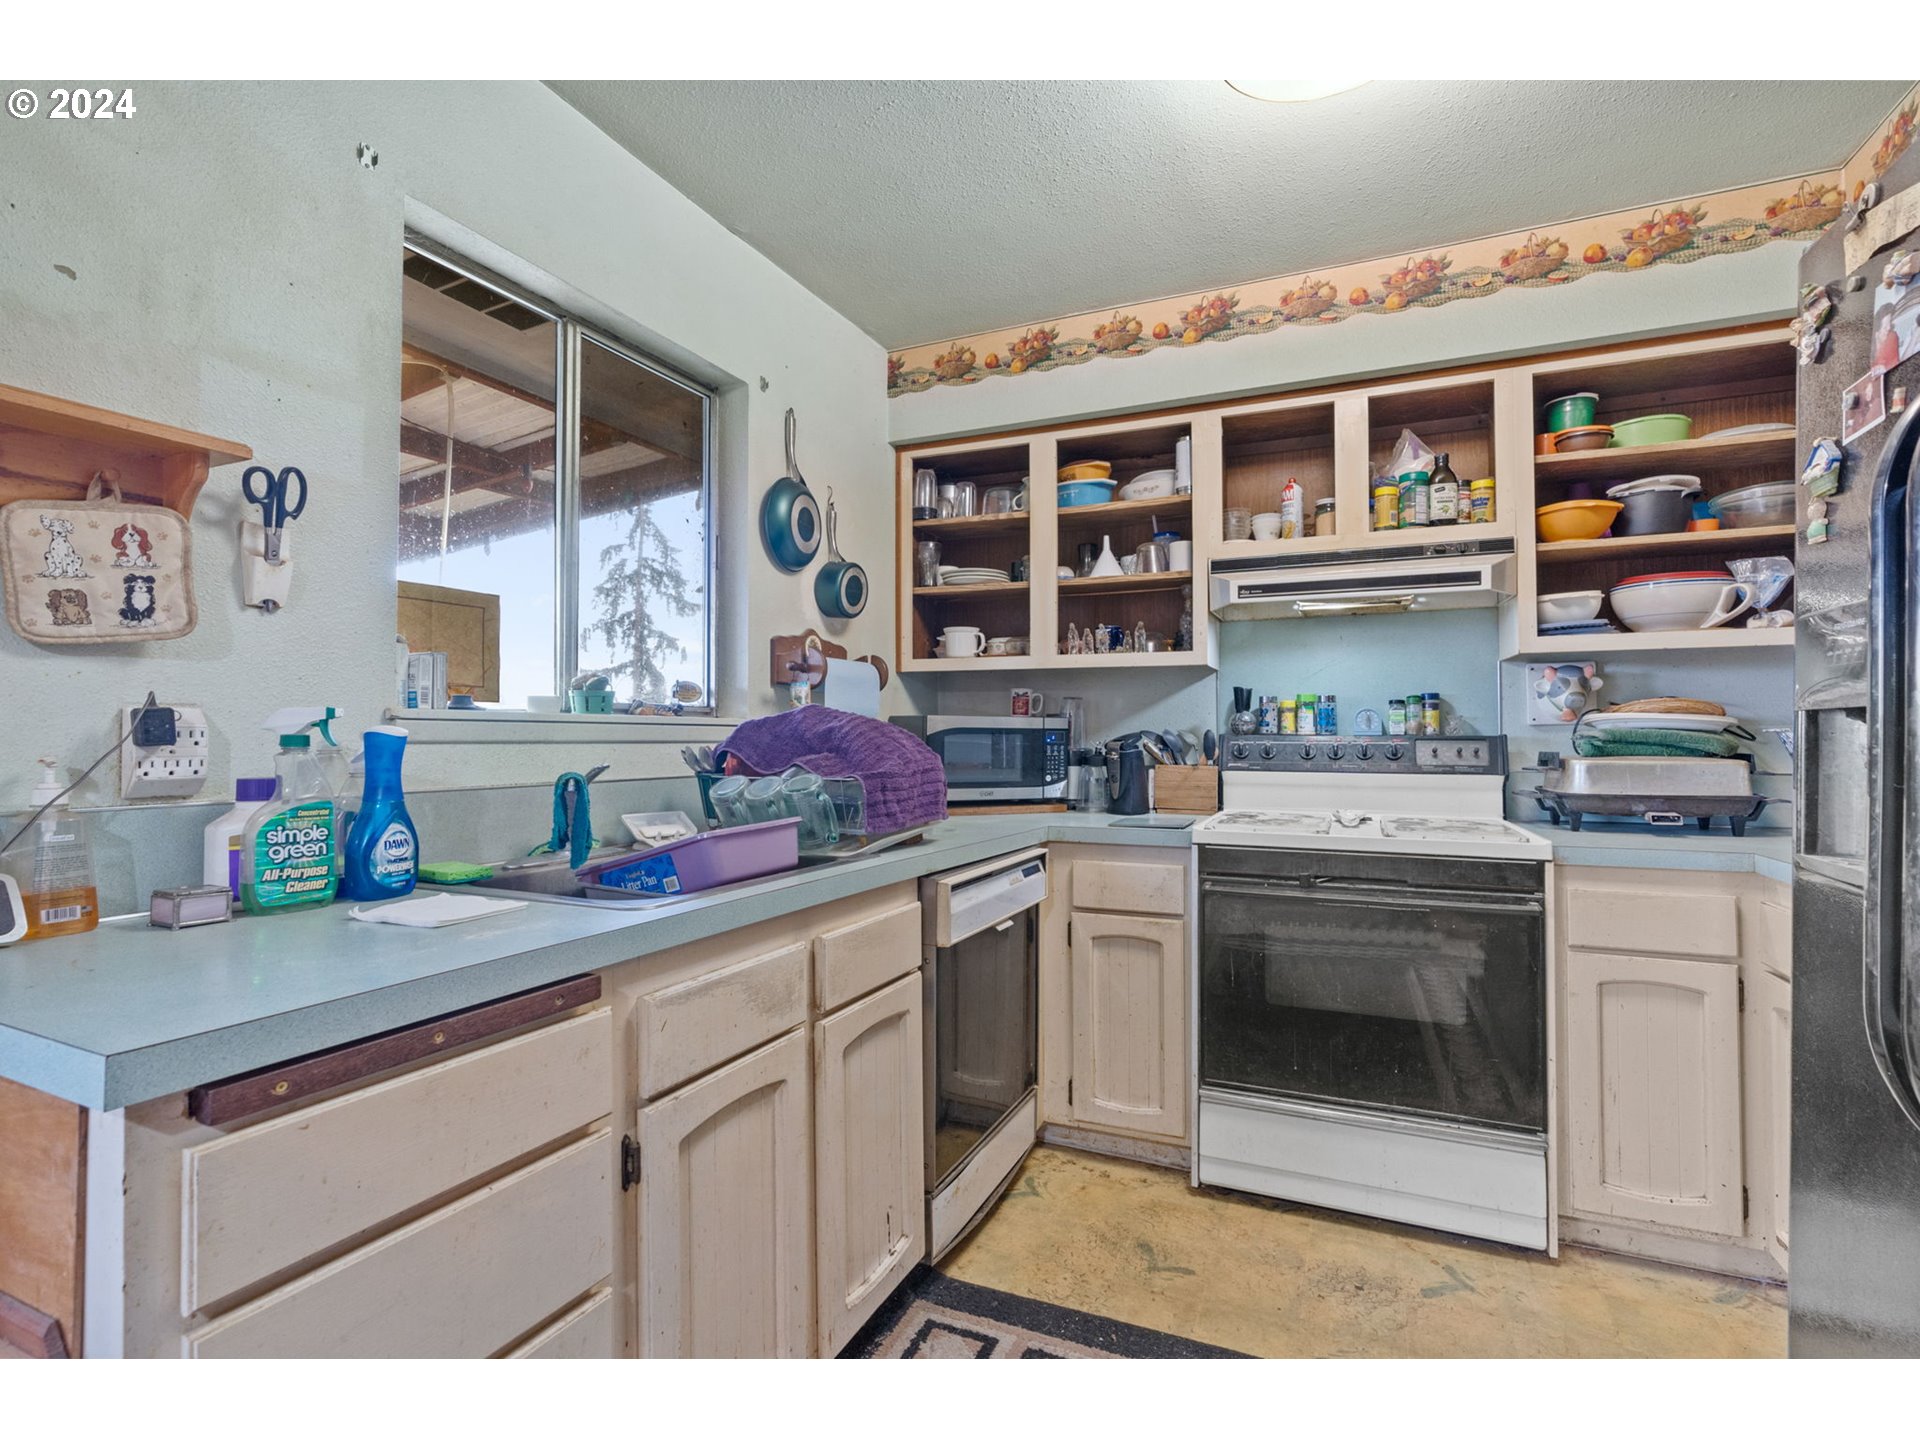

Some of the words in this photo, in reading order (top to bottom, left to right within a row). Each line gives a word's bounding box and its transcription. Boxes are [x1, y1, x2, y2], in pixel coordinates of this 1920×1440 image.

[266, 824, 328, 845] simple
[383, 838, 410, 850] DAWN
[268, 841, 327, 864] green
[262, 865, 329, 881] All-Purpose
[285, 879, 328, 893] Cleaner
[641, 875, 658, 888] Pan
